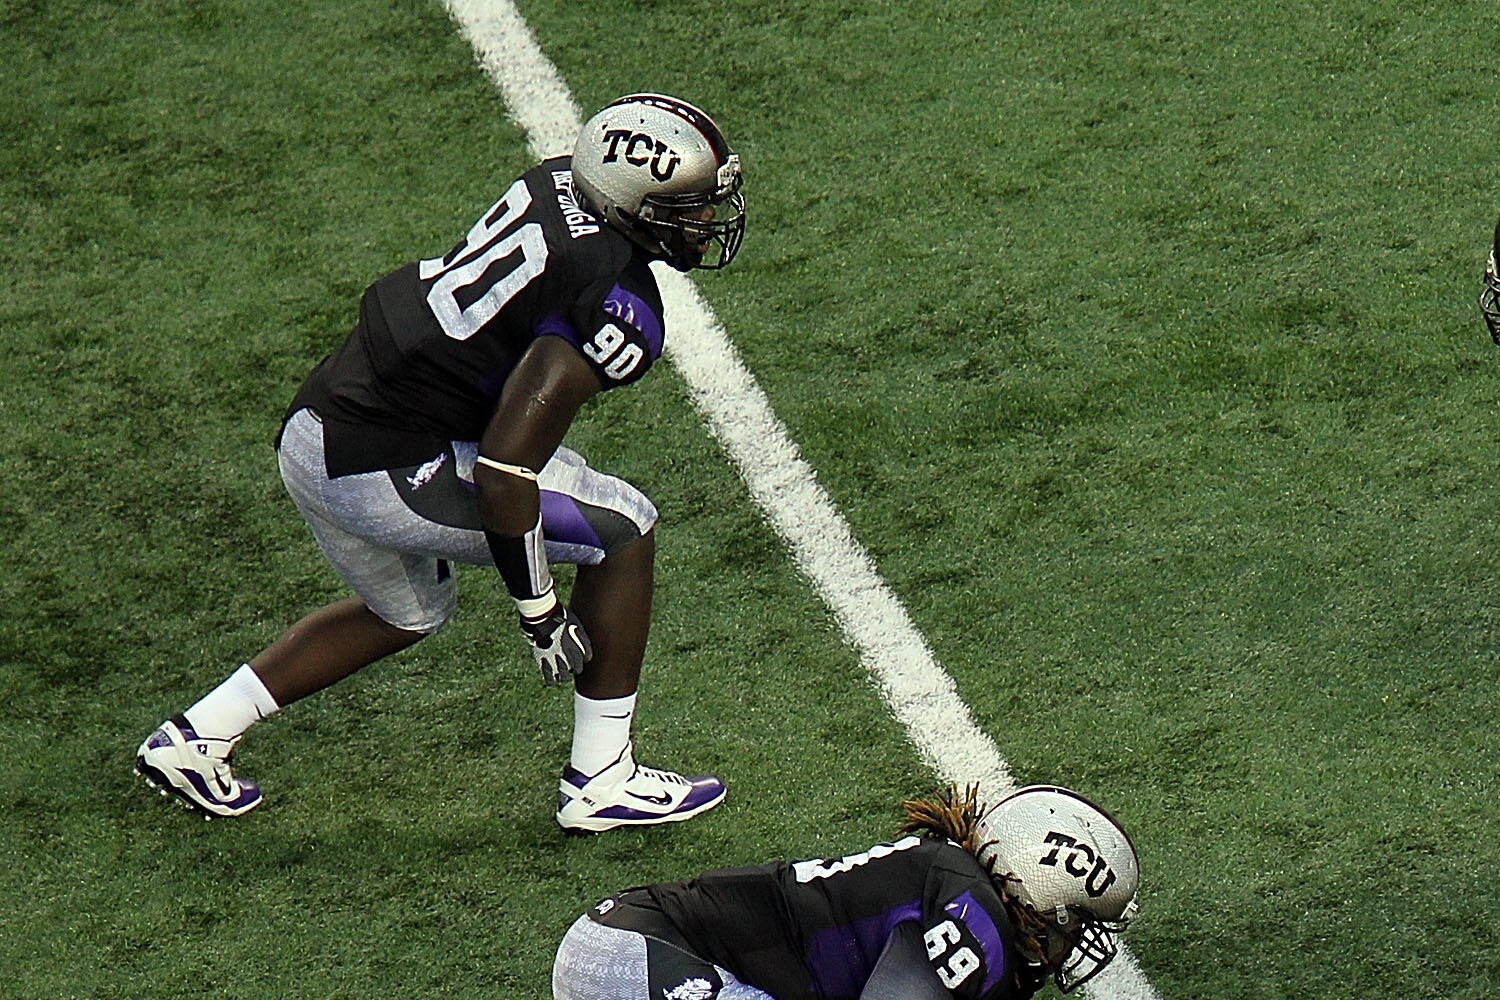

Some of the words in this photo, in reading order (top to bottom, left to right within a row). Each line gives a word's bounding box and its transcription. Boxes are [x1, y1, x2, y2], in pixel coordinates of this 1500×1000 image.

[602, 128, 681, 183] TCU
[419, 179, 549, 341] 90
[583, 322, 644, 381] 90
[1043, 831, 1117, 898] TCU
[921, 919, 981, 991] 69
